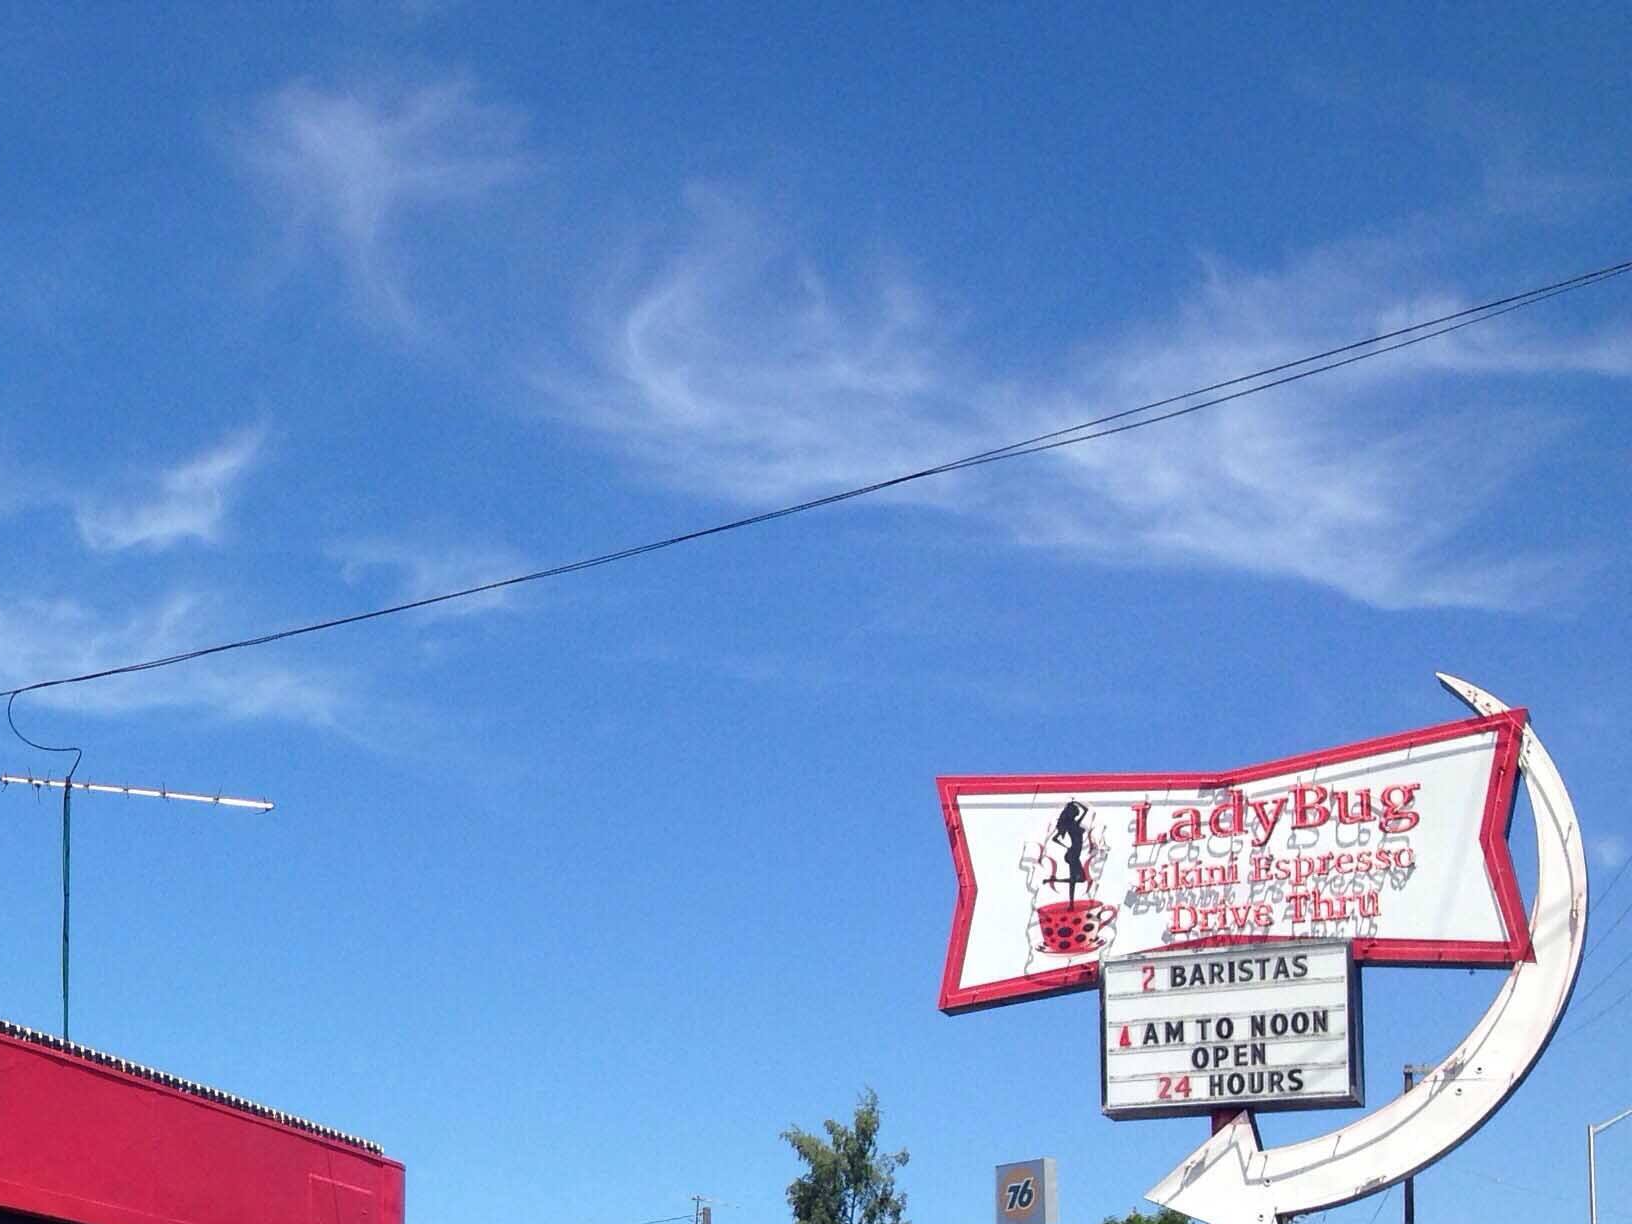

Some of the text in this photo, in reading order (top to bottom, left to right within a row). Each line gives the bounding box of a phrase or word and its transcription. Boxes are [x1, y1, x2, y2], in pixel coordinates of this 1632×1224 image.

[1131, 783, 1421, 847] LadyBug
[1135, 848, 1414, 894] Bikini Espresso
[1170, 888, 1382, 933] Drive Thru
[1142, 955, 1308, 992] 2 BARISTAS
[1143, 1021, 1184, 1045] AM
[1196, 1017, 1234, 1040] TO
[1251, 1009, 1328, 1037] NOON
[1191, 1043, 1266, 1069] OPEN
[1159, 1068, 1304, 1099] 24 HOURS
[1006, 1177, 1035, 1211] 76
